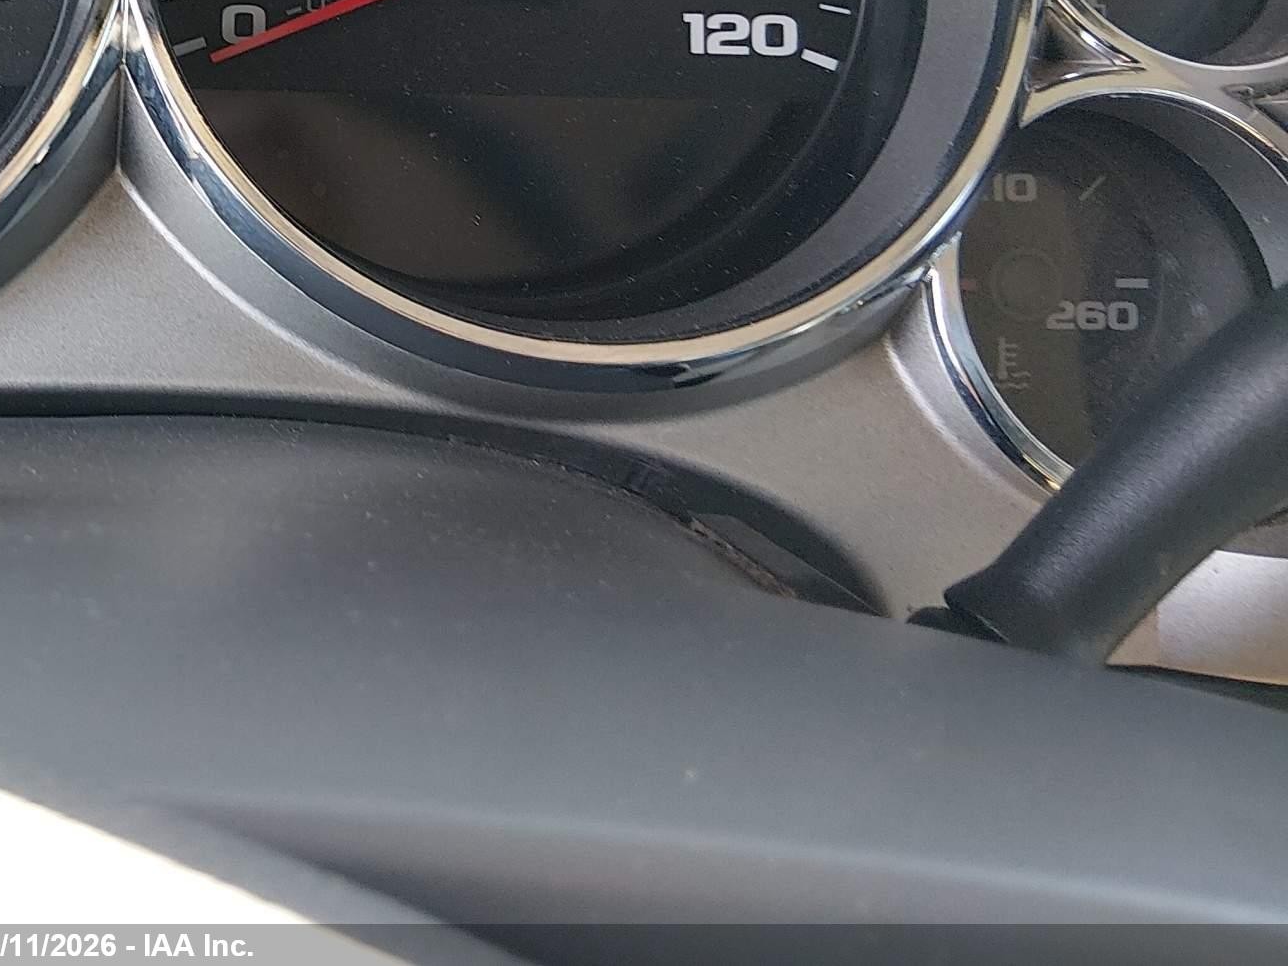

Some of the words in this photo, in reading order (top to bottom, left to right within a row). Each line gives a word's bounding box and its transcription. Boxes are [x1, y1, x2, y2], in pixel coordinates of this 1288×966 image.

[222, 4, 266, 45] 0
[682, 13, 799, 58] 120
[982, 173, 1038, 203] 10
[1045, 300, 1140, 333] 260
